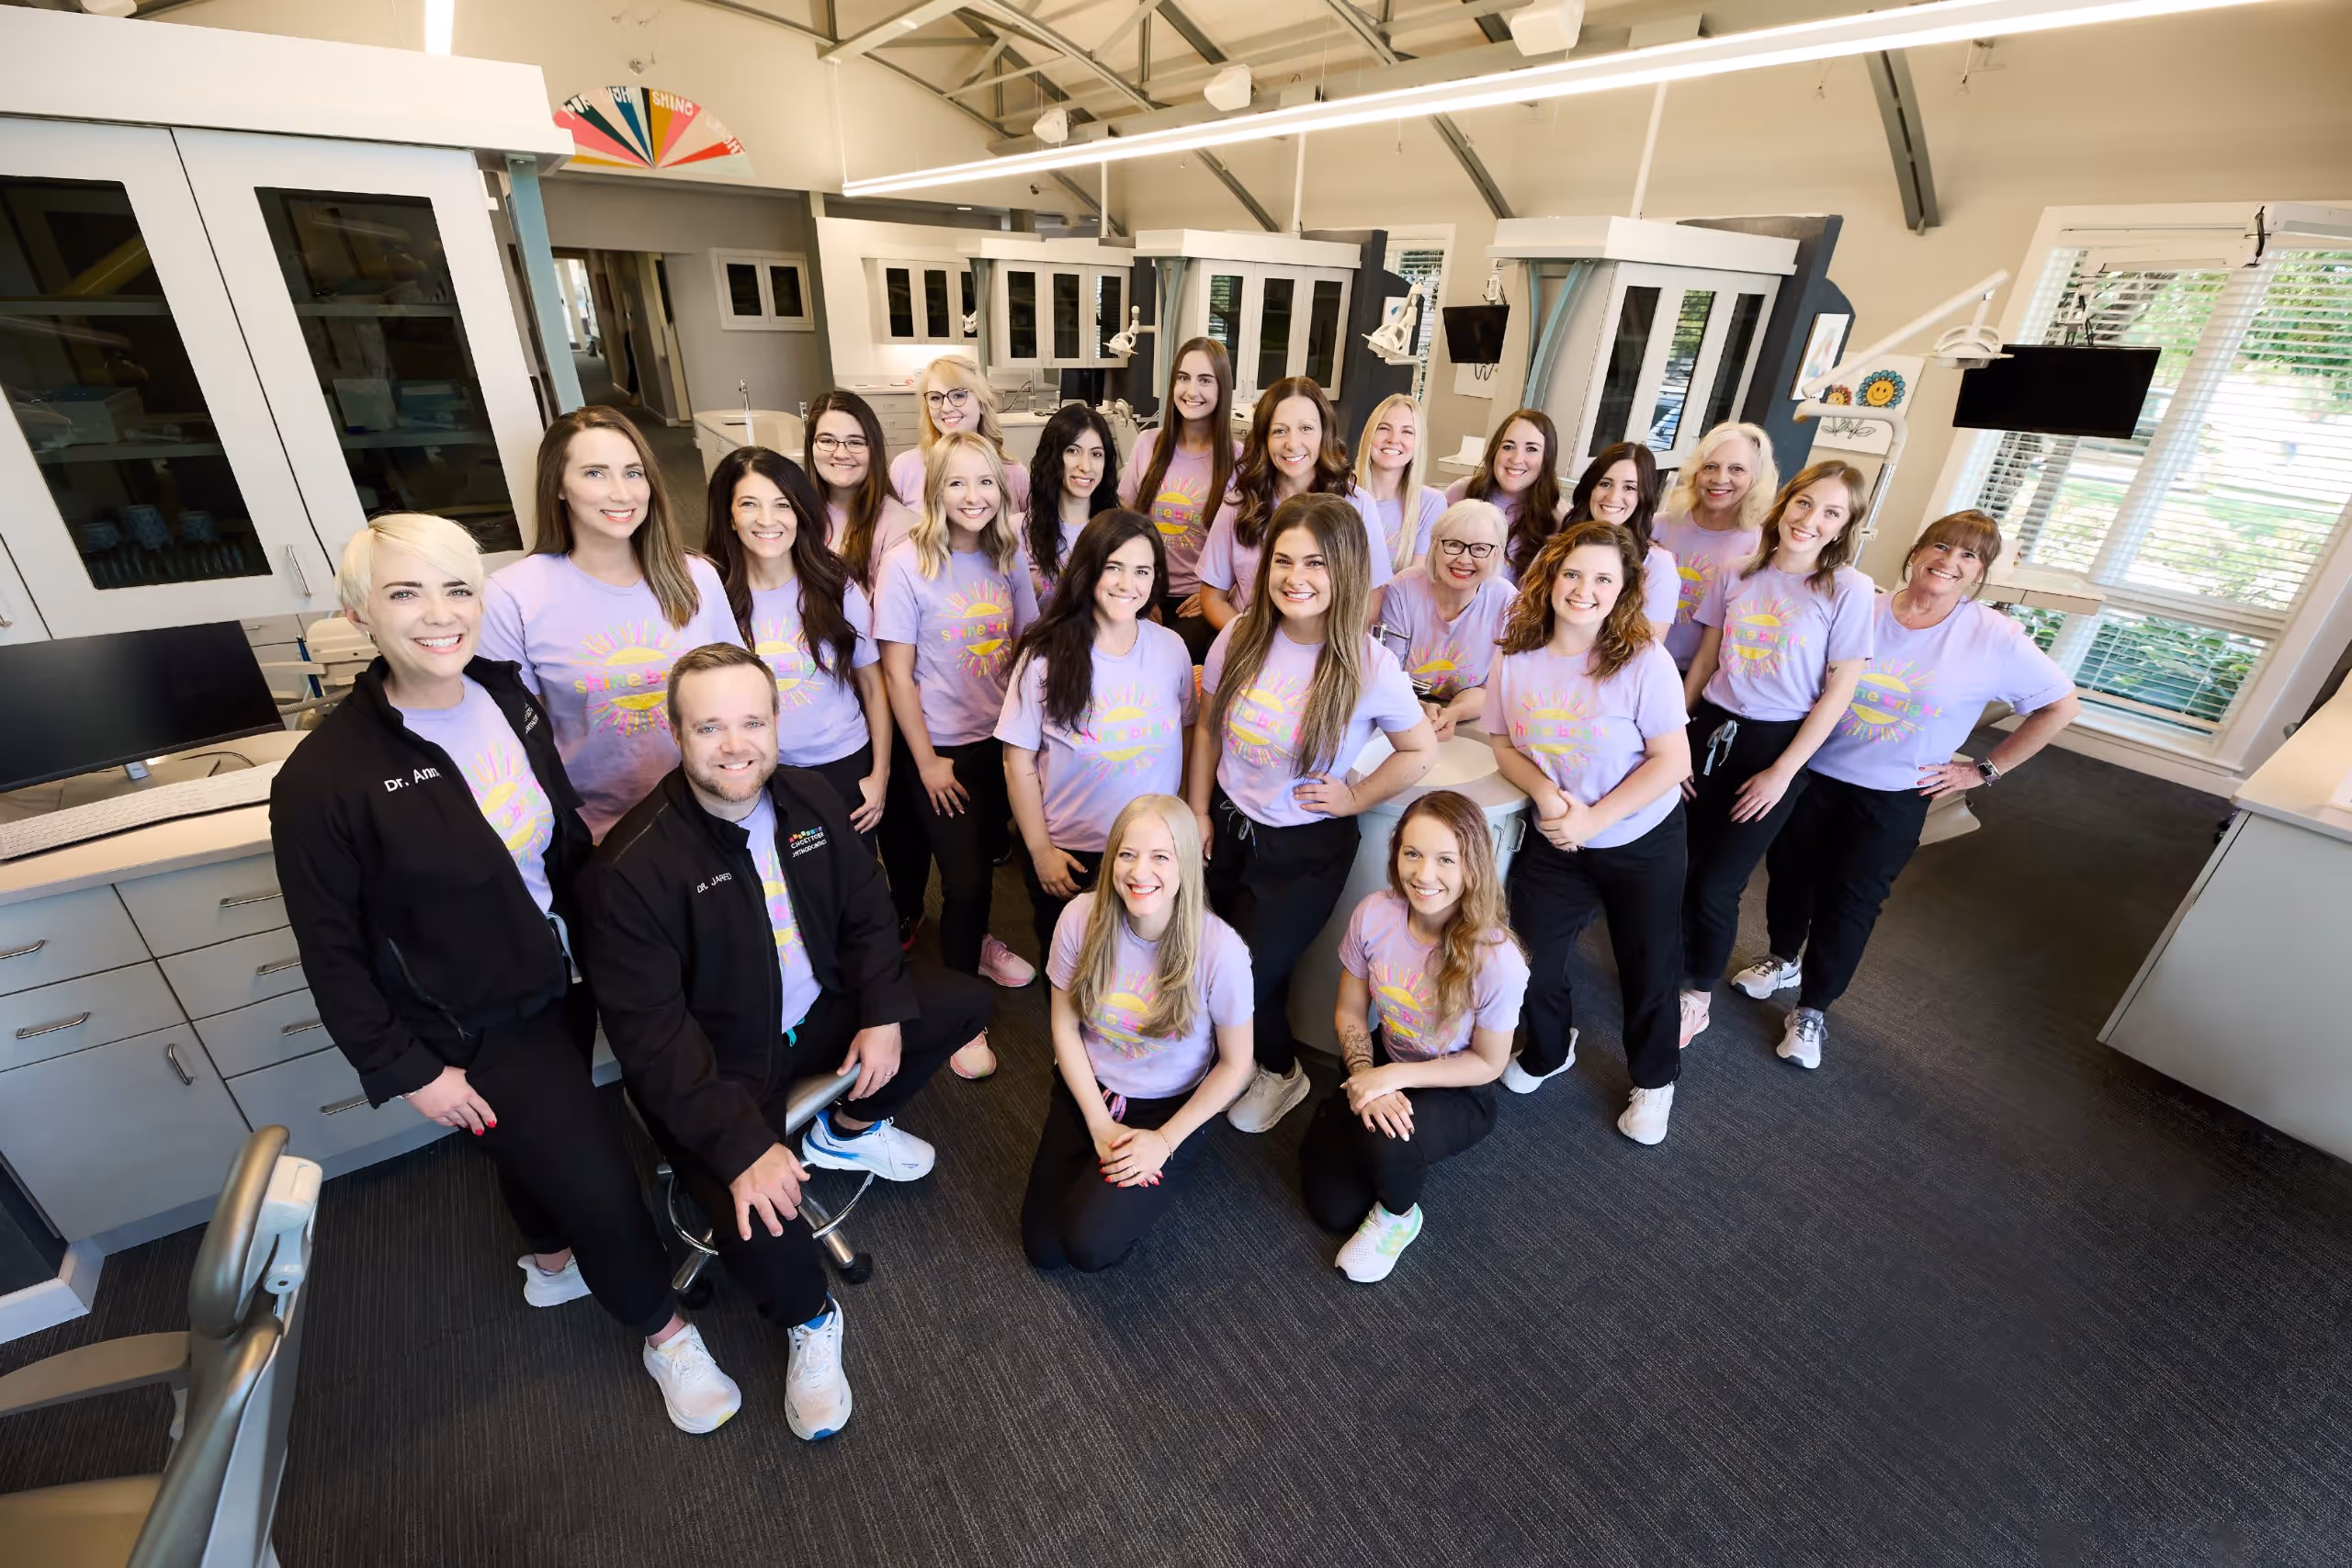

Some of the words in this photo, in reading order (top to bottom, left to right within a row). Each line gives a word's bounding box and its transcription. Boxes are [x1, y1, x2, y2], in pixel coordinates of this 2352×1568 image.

[573, 671, 642, 694] shine
[1883, 693, 1943, 718] bright
[1069, 726, 1128, 745] shine
[1131, 716, 1175, 739] bright
[383, 777, 410, 792] Dr.
[696, 882, 708, 894] DR.
[711, 872, 732, 886] JARED
